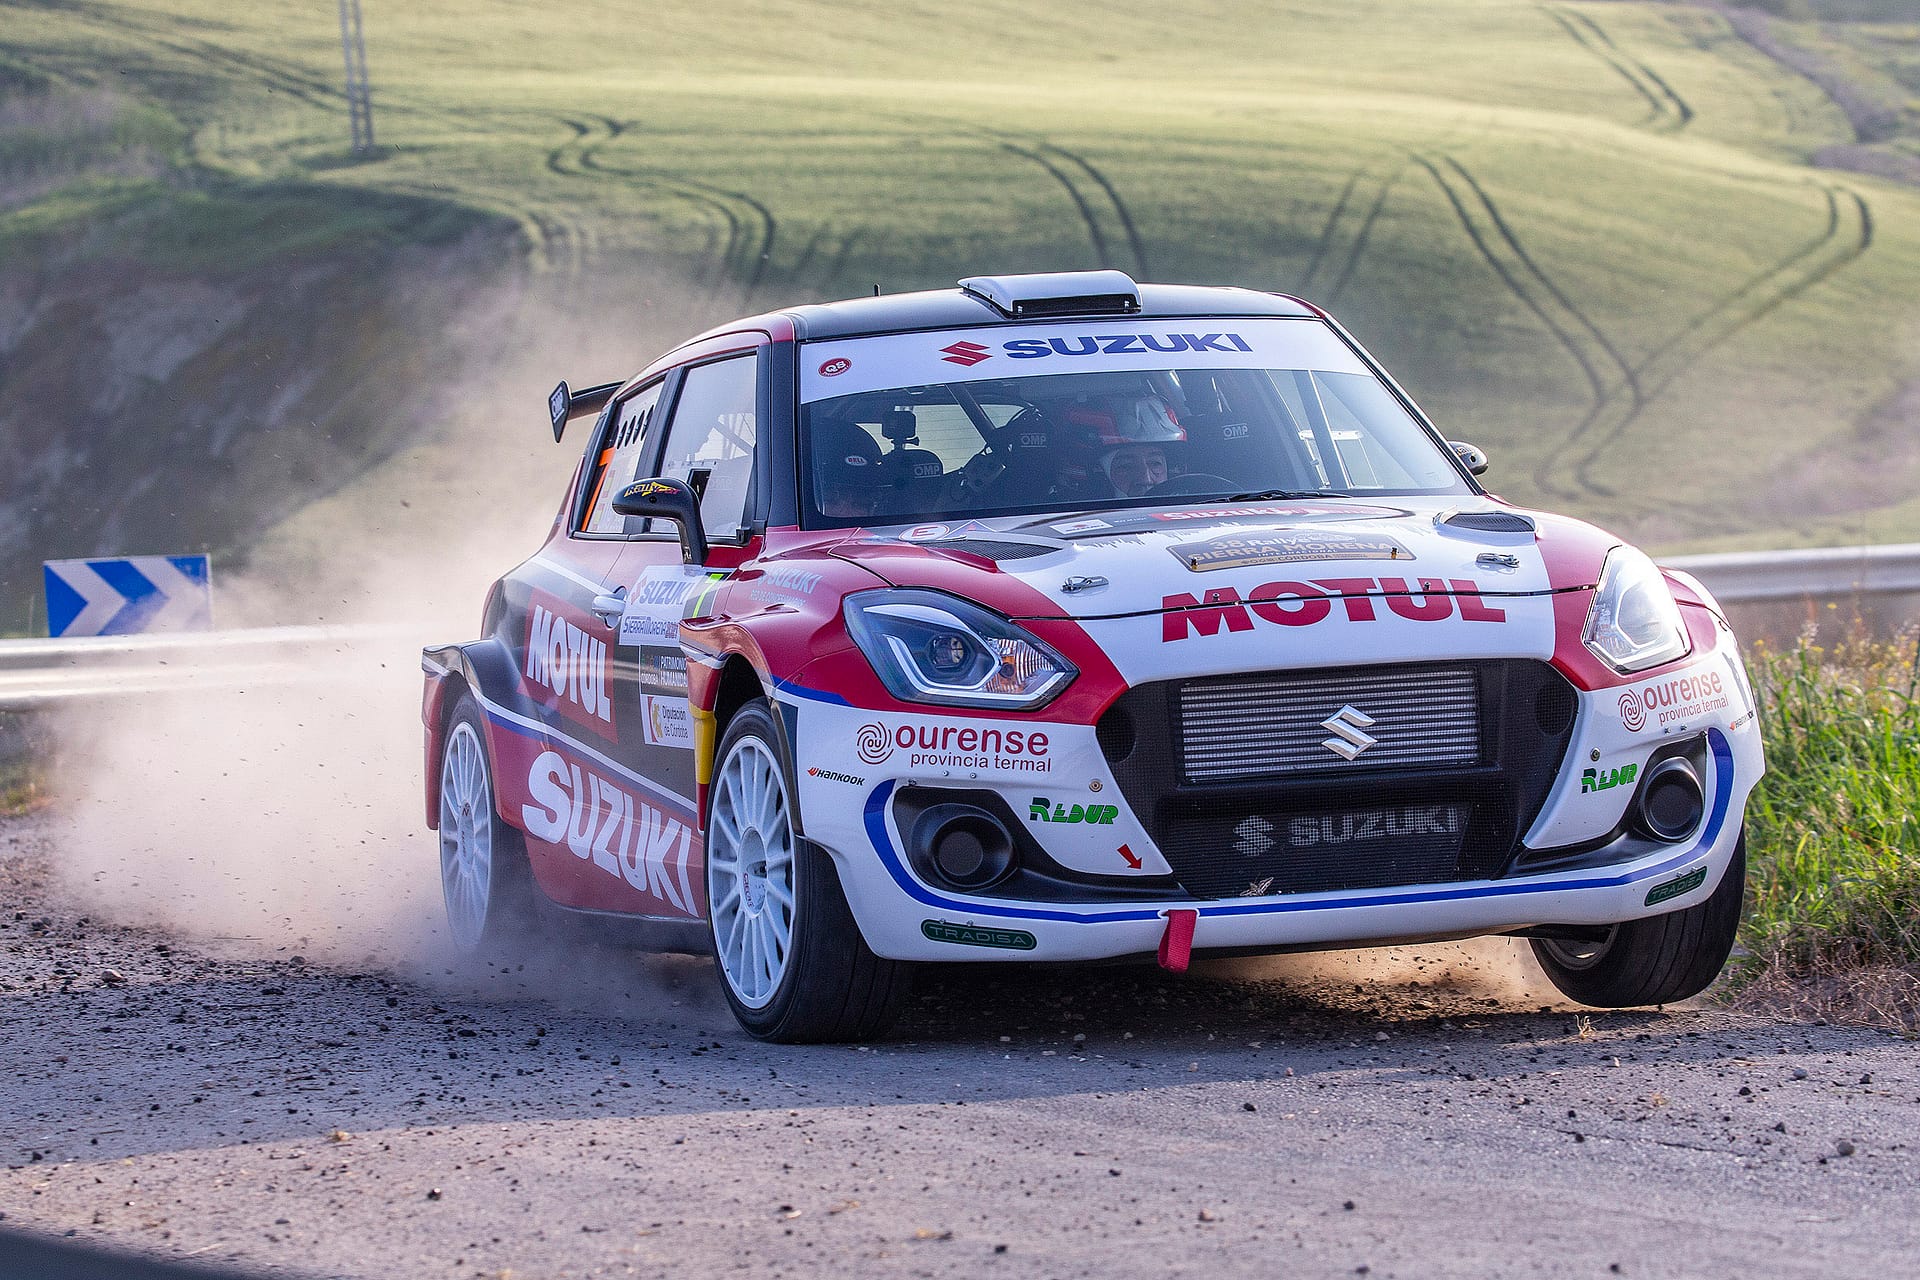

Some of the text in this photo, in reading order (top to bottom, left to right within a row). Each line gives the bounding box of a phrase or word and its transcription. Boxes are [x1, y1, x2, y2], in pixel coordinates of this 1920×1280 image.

[1002, 333, 1253, 359] SUZUKI
[1021, 435, 1047, 445] OMP
[1223, 424, 1248, 438] OMP
[914, 464, 940, 476] OMP
[1188, 542, 1392, 561] SIERRA MORENA
[1209, 539, 1246, 550] 38
[639, 580, 696, 605] SUZUKI
[1162, 578, 1506, 643] MOTUL
[526, 605, 611, 723] MOTUL
[1643, 671, 1723, 710] ourense
[1659, 694, 1729, 727] provincia termal
[896, 725, 1049, 755] ourense
[910, 752, 1051, 772] provincia termal
[1581, 763, 1638, 793] REDUR
[1029, 797, 1119, 824] REDUR
[522, 751, 699, 918] SUZUKI
[1288, 806, 1458, 846] SUZUKI
[930, 926, 1027, 944] TRADISA
